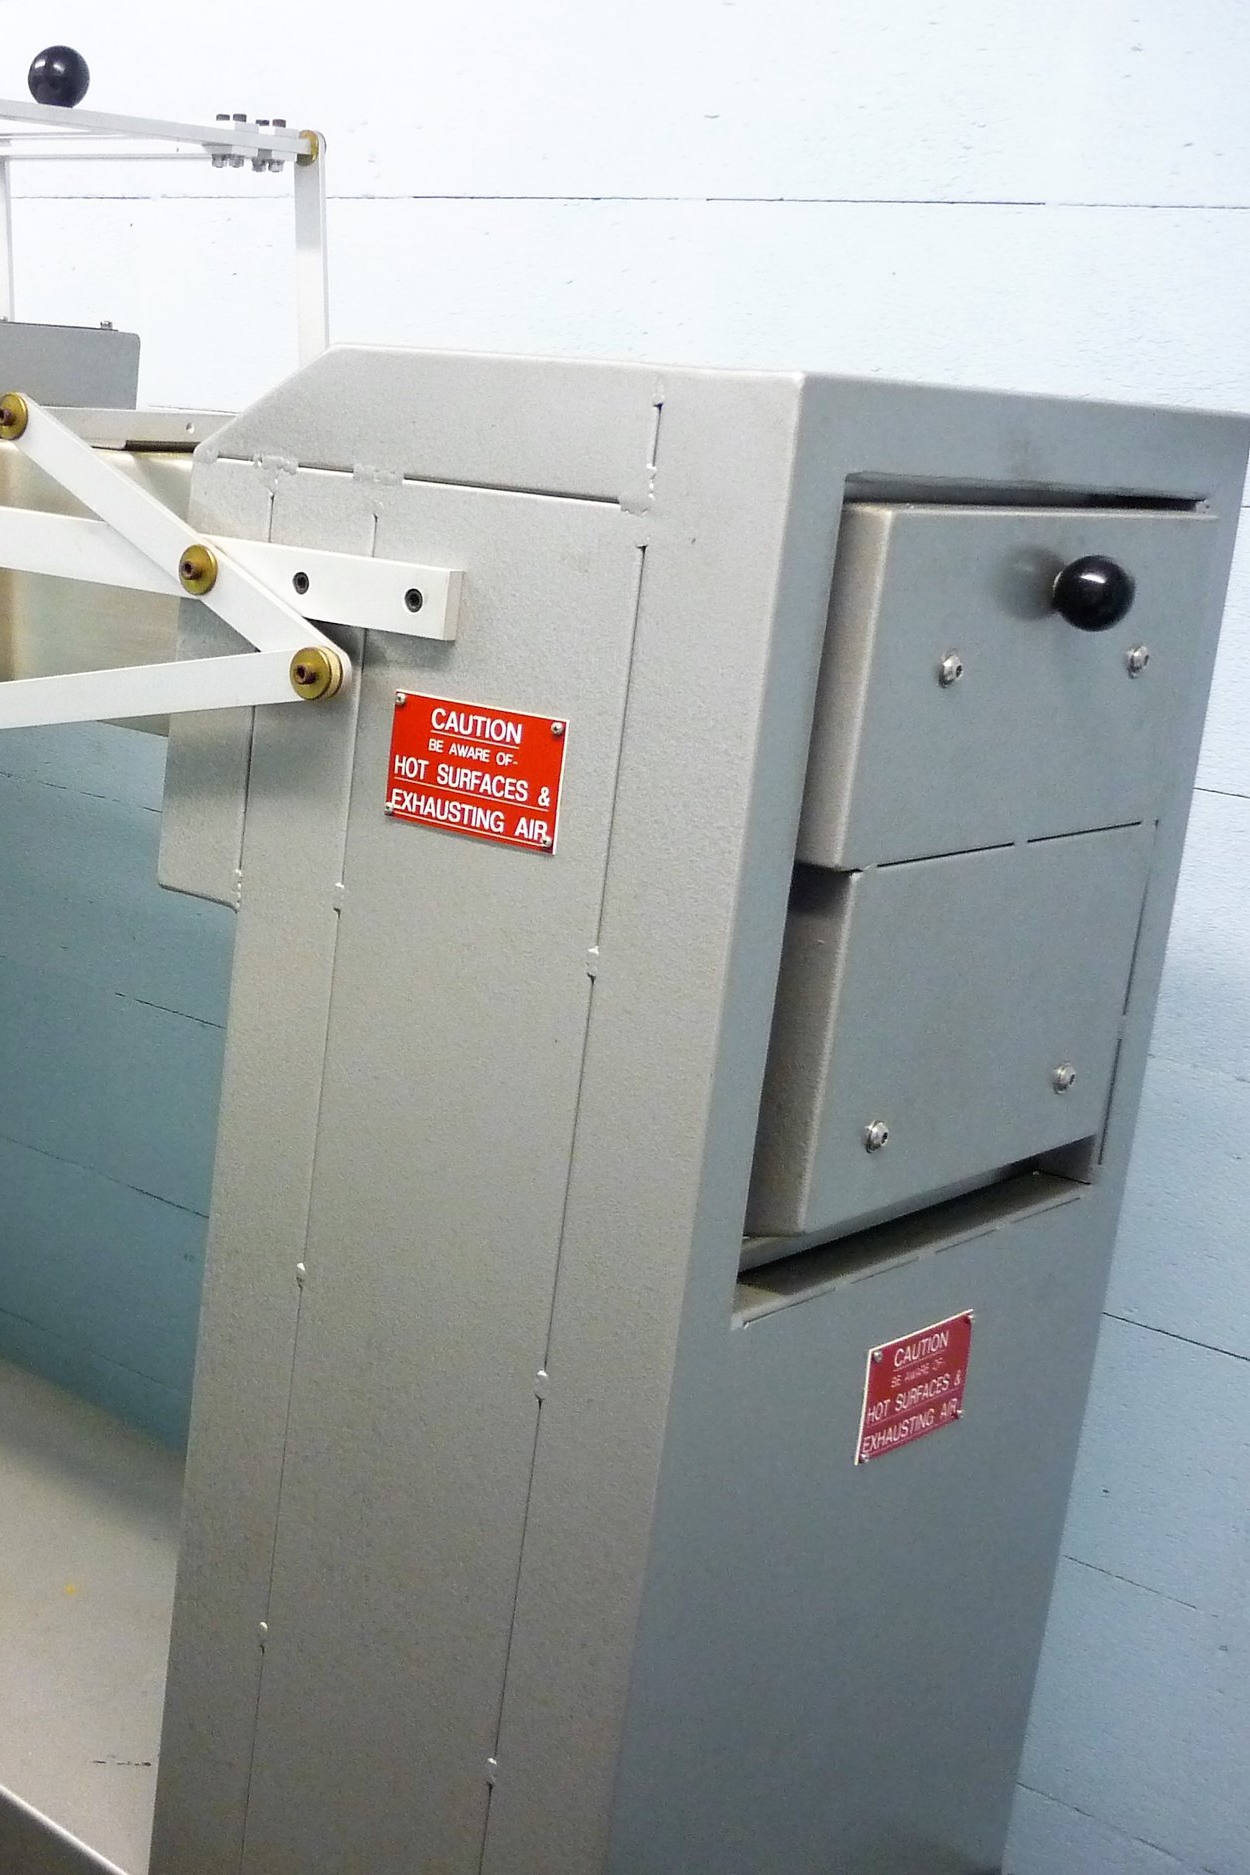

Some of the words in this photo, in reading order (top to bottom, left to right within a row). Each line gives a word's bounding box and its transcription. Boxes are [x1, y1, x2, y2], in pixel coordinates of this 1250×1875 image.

[428, 738, 444, 753] BE
[448, 743, 491, 763] AWARE
[431, 708, 523, 744] CAUTION
[394, 755, 429, 780] HOT
[436, 763, 528, 802] SURFACES
[537, 786, 550, 807] &
[391, 788, 505, 832] EXHAUSTING
[514, 816, 549, 841] AIR
[893, 1330, 949, 1367] CAUTION
[867, 1398, 891, 1424] HOT
[895, 1373, 950, 1412] SURFACES
[954, 1369, 962, 1386] &
[862, 1408, 935, 1453] EXHAUSTING
[940, 1397, 958, 1420] AIR
